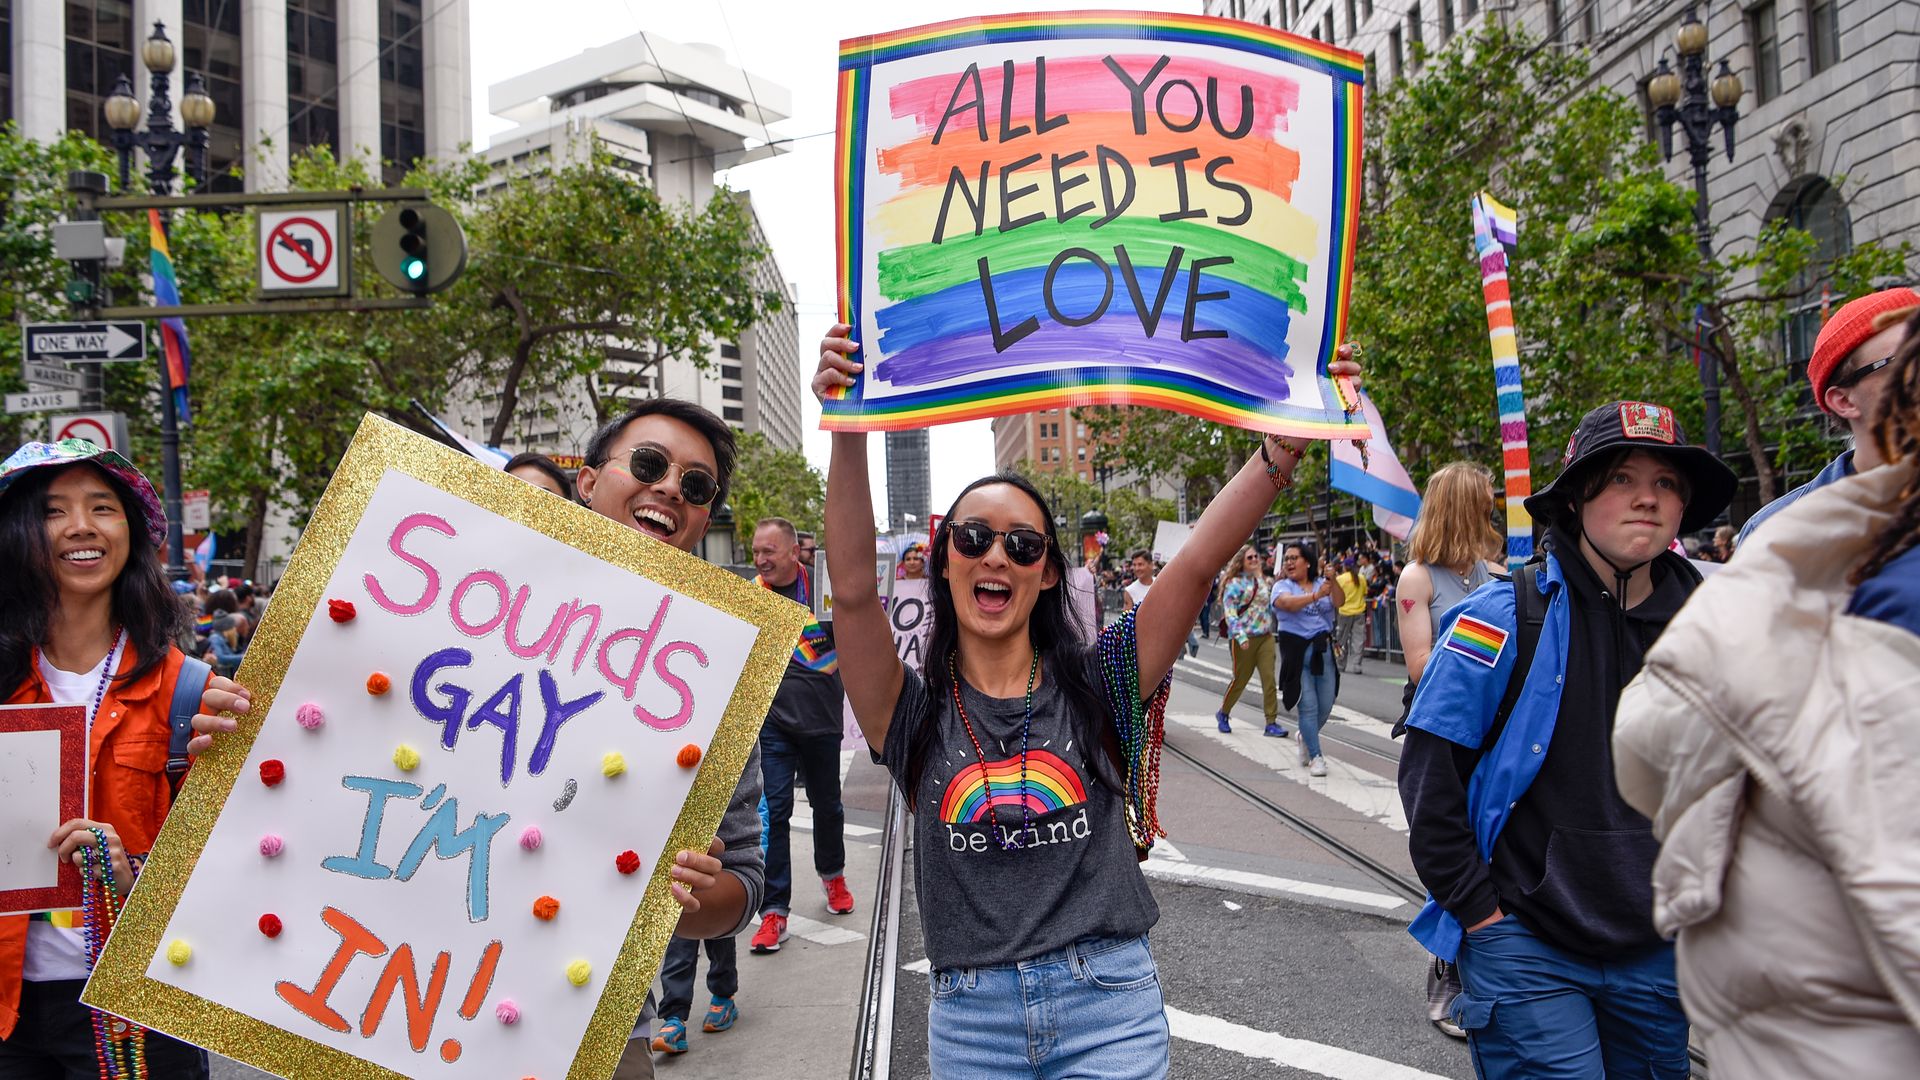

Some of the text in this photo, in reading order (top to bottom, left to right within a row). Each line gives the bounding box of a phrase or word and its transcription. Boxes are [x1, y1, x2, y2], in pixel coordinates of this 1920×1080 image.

[932, 55, 1254, 144] ALL YOU
[932, 144, 1253, 244] NEED IS
[37, 335, 106, 351] ONE WAY
[977, 244, 1234, 353] LOVE
[20, 394, 63, 408] DAVIS
[33, 368, 76, 386] MARKET
[363, 511, 709, 732] Sounds
[320, 774, 511, 923] I'M
[946, 808, 1092, 853] be kind
[274, 904, 503, 1064] IN!
